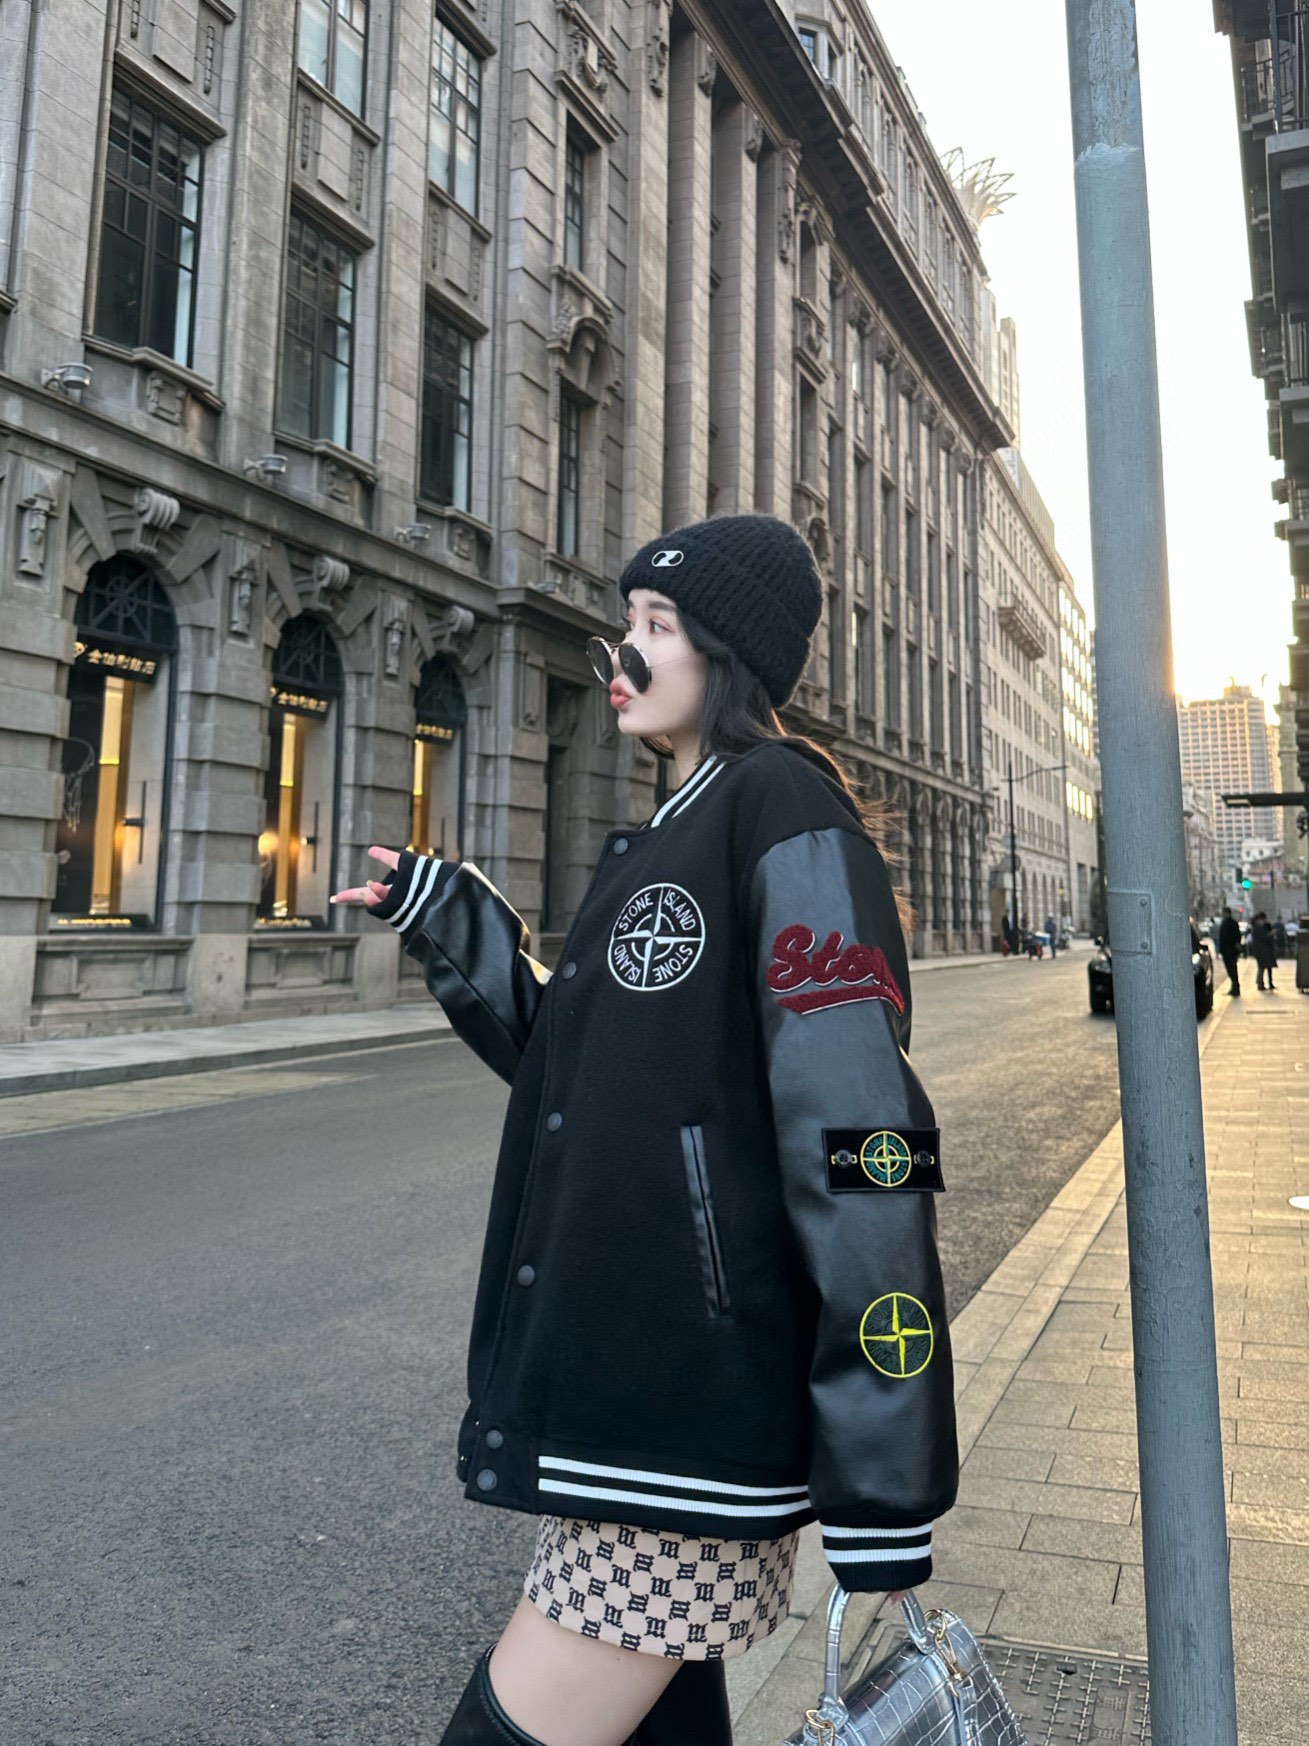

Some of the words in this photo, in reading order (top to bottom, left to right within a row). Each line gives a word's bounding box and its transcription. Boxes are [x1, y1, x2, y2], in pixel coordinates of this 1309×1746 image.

[618, 892, 654, 931] STONE
[663, 889, 696, 931] ISLAND
[614, 943, 642, 983] ISLAND
[652, 944, 693, 983] STONE
